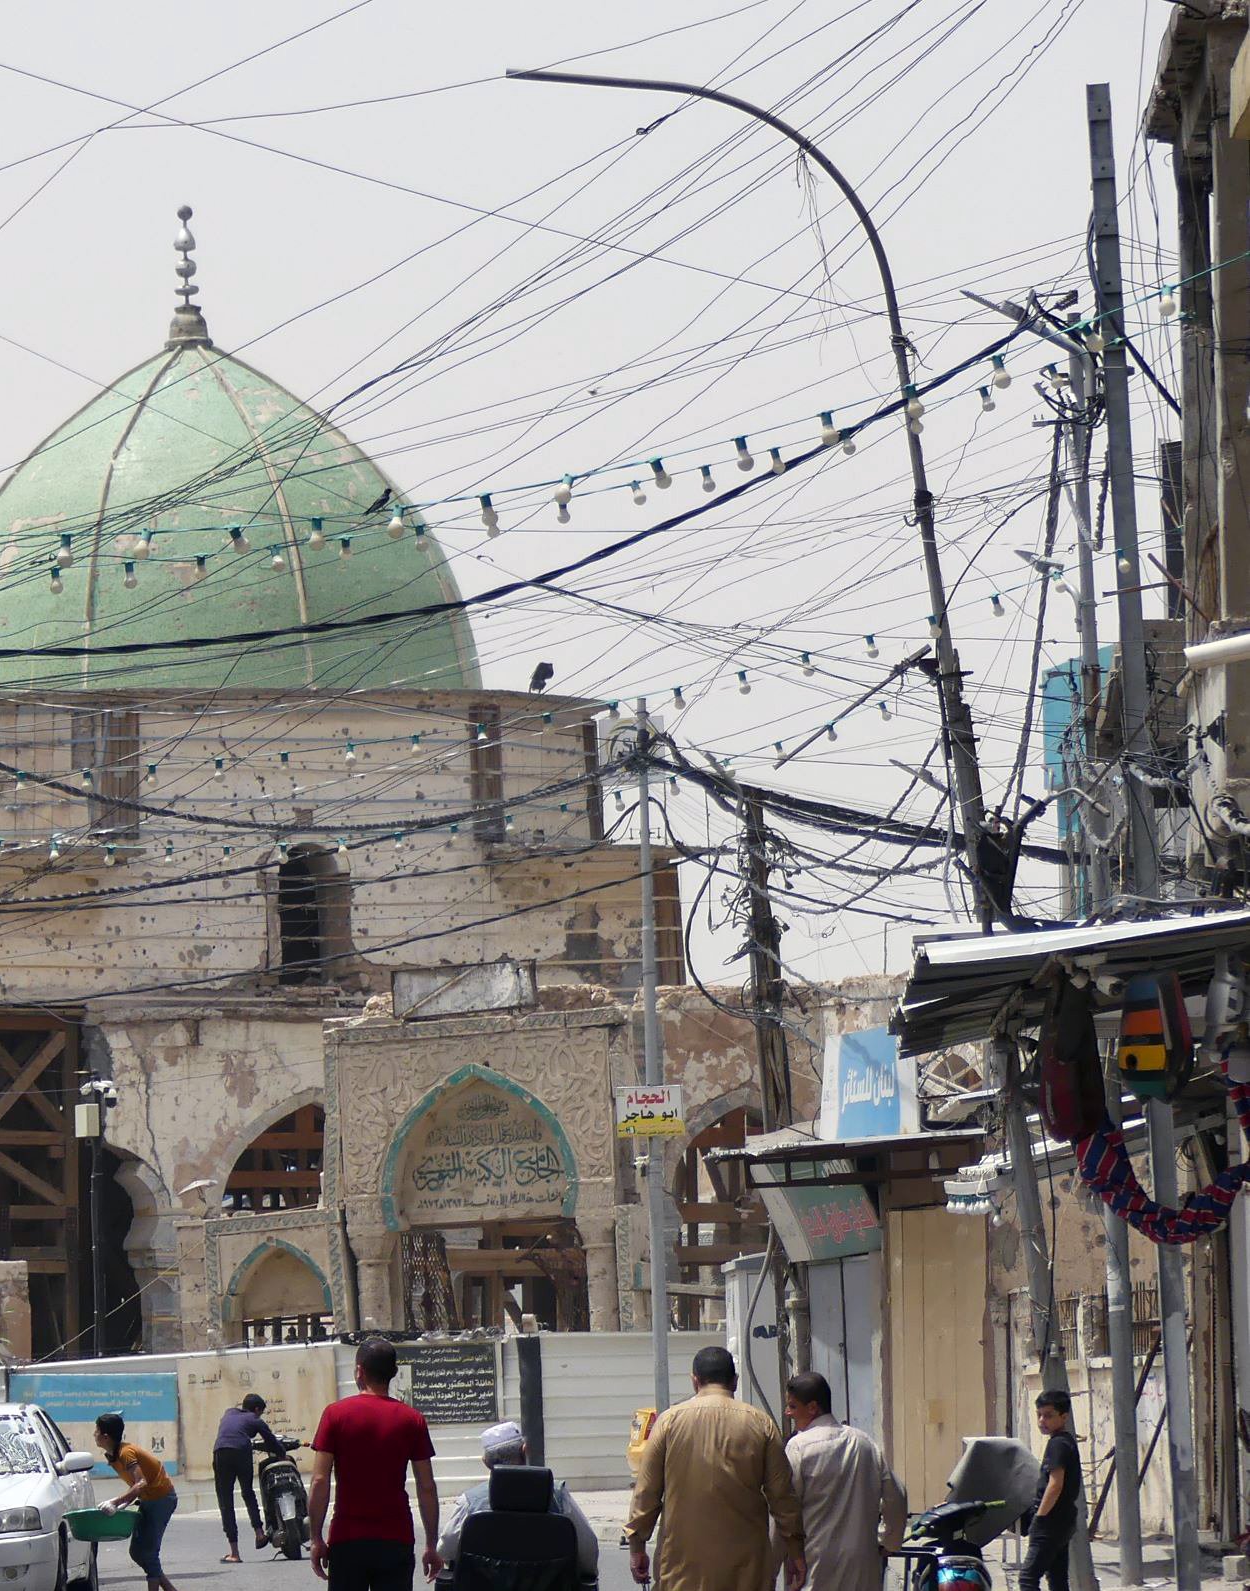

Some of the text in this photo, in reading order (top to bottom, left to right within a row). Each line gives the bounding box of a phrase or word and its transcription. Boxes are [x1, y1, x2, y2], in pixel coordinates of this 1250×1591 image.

[873, 1062, 895, 1108] لبنان
[626, 1088, 671, 1109] الحجام
[622, 1108, 678, 1123] ابو هاجر
[448, 1380, 474, 1389] الدكتور
[456, 1389, 477, 1400] مشروع
[478, 1390, 494, 1399] مدير
